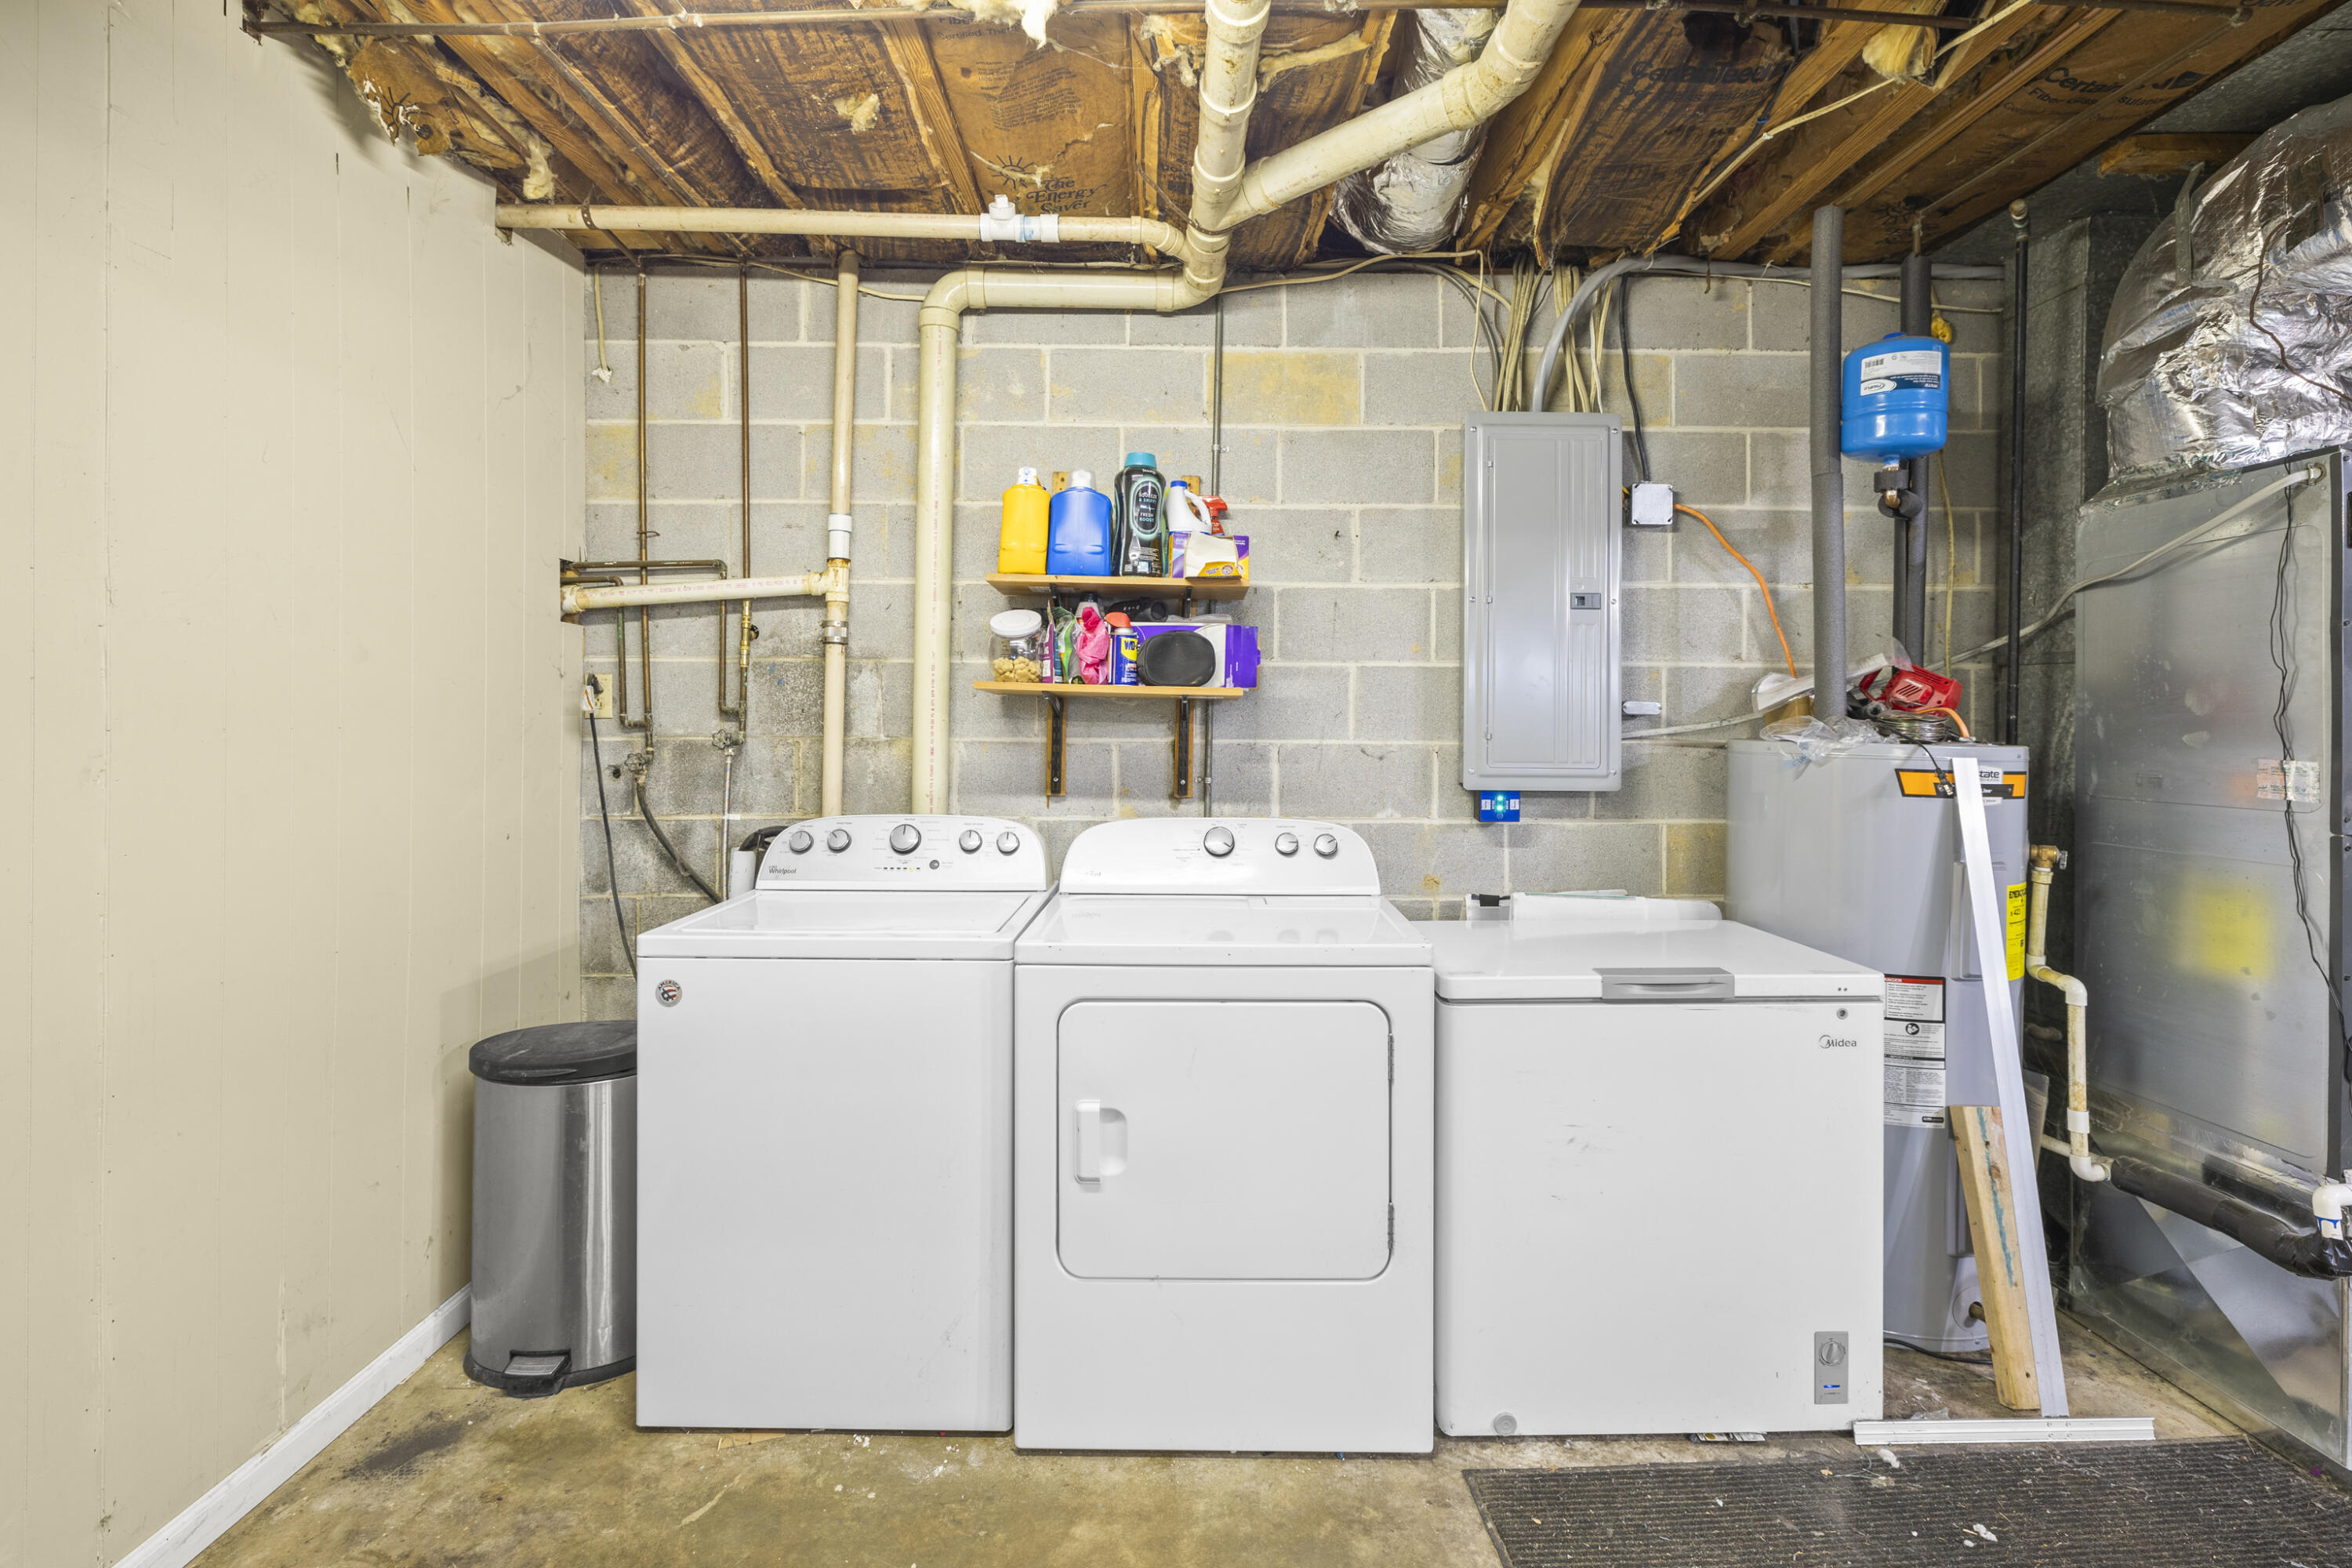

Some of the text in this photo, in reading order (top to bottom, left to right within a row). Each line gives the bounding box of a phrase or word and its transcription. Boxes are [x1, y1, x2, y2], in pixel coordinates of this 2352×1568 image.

[2028, 87, 2064, 103] Fiber
[1040, 176, 1076, 191] The
[1026, 183, 1107, 203] Energy
[1040, 198, 1091, 214] Saver
[1822, 1036, 1857, 1047] Midea
